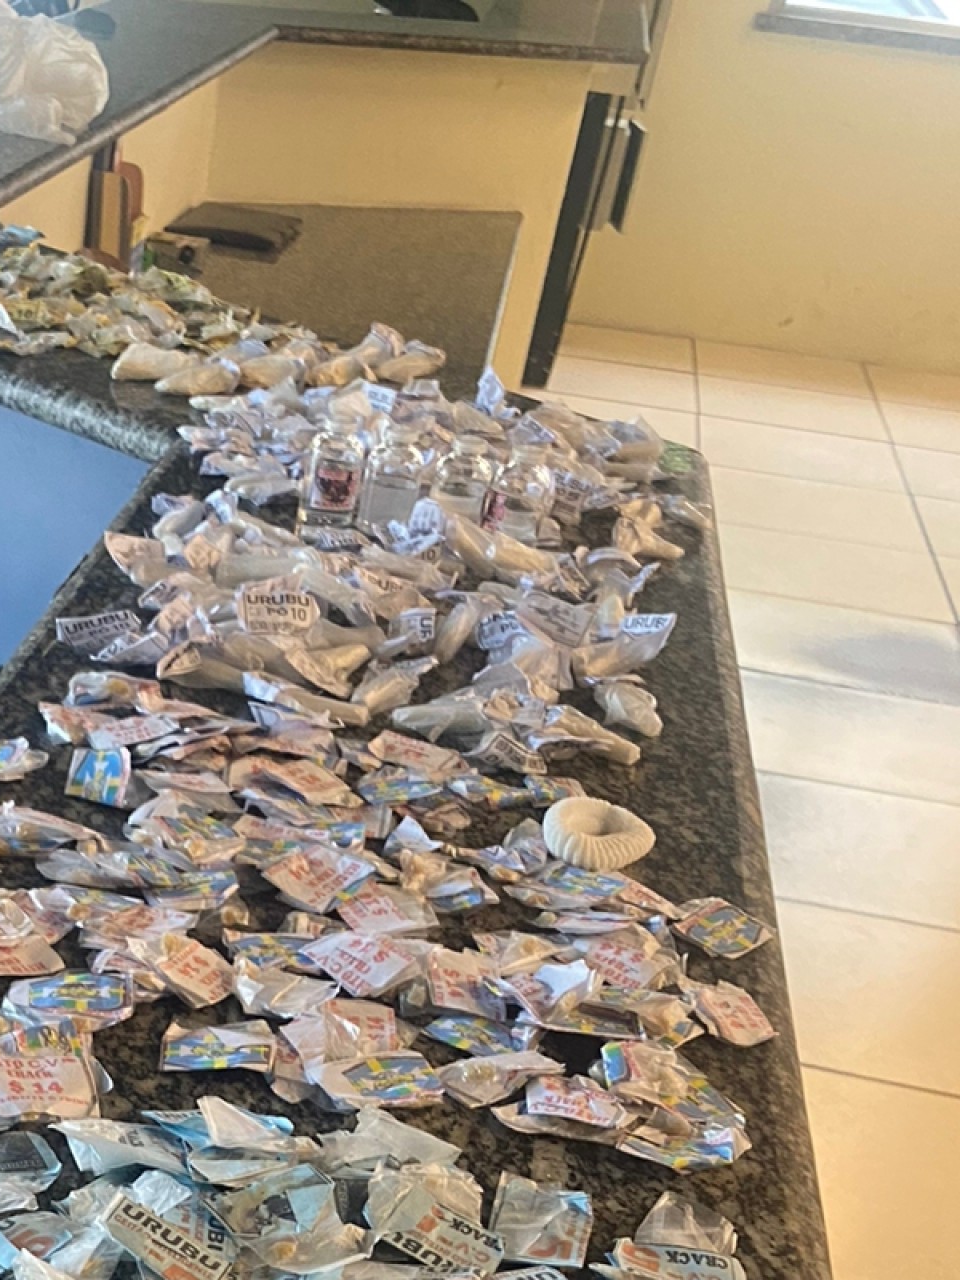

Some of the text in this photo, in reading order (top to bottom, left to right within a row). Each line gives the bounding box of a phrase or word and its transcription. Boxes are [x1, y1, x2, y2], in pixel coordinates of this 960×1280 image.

[247, 593, 310, 607] URUBU
[65, 609, 129, 634] URUBU
[290, 607, 307, 621] 10
[122, 1203, 222, 1271] URUBU
[665, 1249, 730, 1269] CRACK
